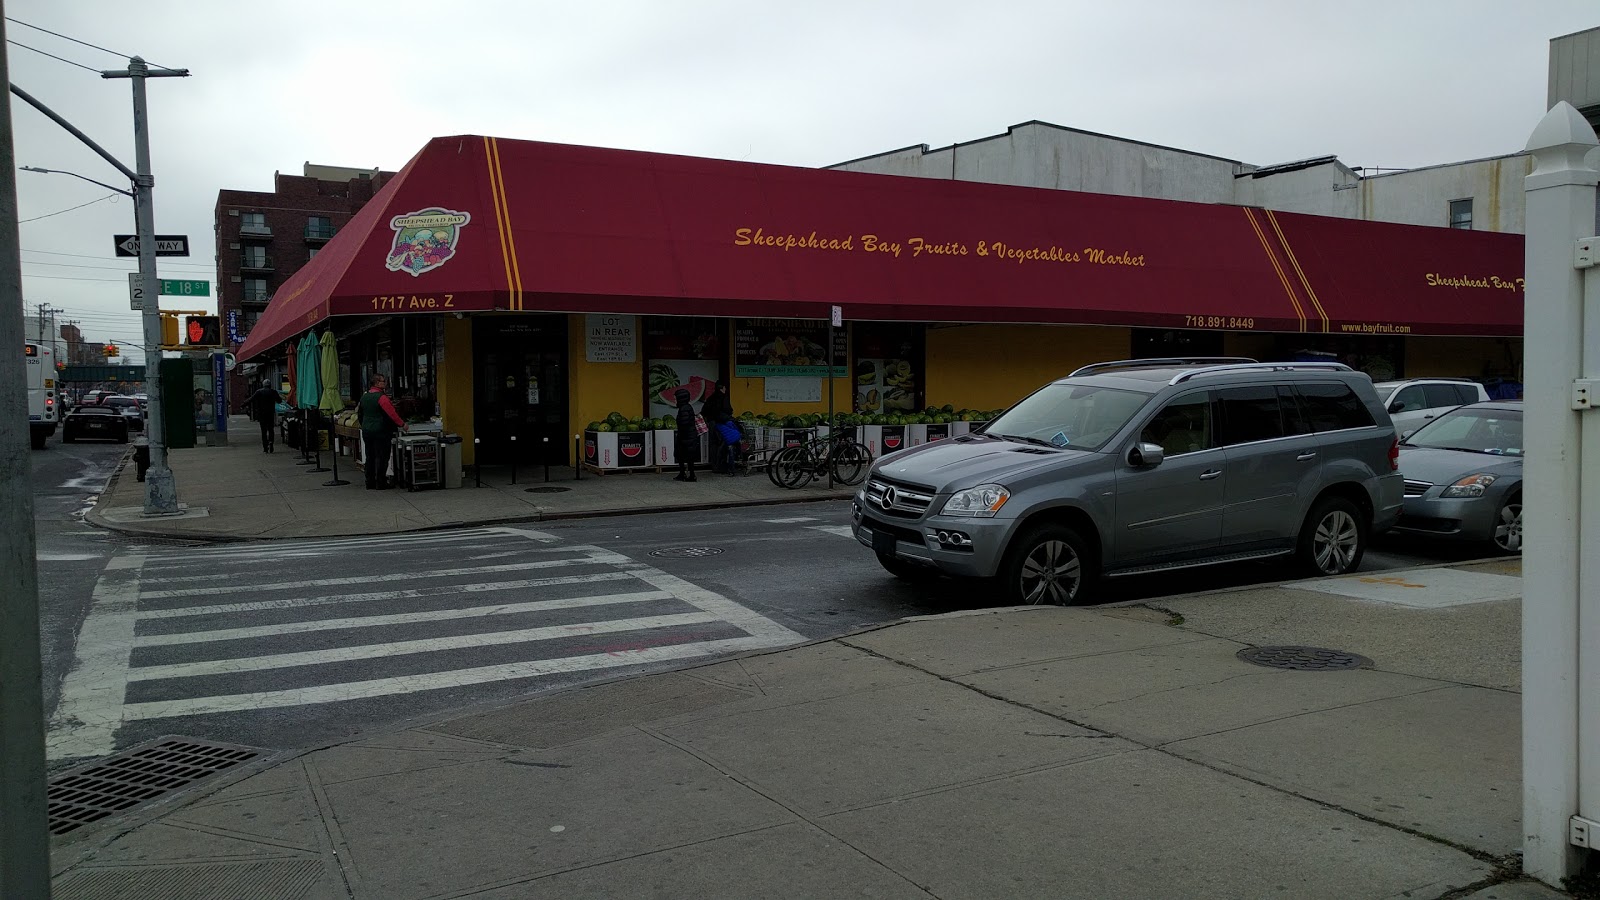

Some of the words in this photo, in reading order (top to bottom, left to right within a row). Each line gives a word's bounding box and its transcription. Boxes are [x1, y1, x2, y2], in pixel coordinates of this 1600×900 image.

[396, 217, 446, 225] SHEEPSHEAD
[127, 241, 141, 250] ON
[157, 241, 179, 250] WAY
[734, 228, 854, 251] Sheepshead
[860, 234, 902, 257] Bay
[907, 237, 968, 257] Fruits
[976, 240, 989, 256] &
[992, 241, 1081, 264] Vegetables
[1083, 246, 1146, 267] Market
[164, 281, 173, 294] E
[179, 281, 192, 294] 18
[1425, 273, 1490, 289] Sheepshead
[1490, 276, 1516, 293] Bay
[371, 296, 405, 310] 1717
[409, 295, 440, 309] Ave.
[444, 294, 455, 308] Z
[602, 318, 620, 326] LOT
[1185, 315, 1255, 329] 718.891.8449
[1341, 322, 1411, 334] www.bayfruit.com
[592, 328, 601, 336] IN
[604, 328, 630, 336] REAR
